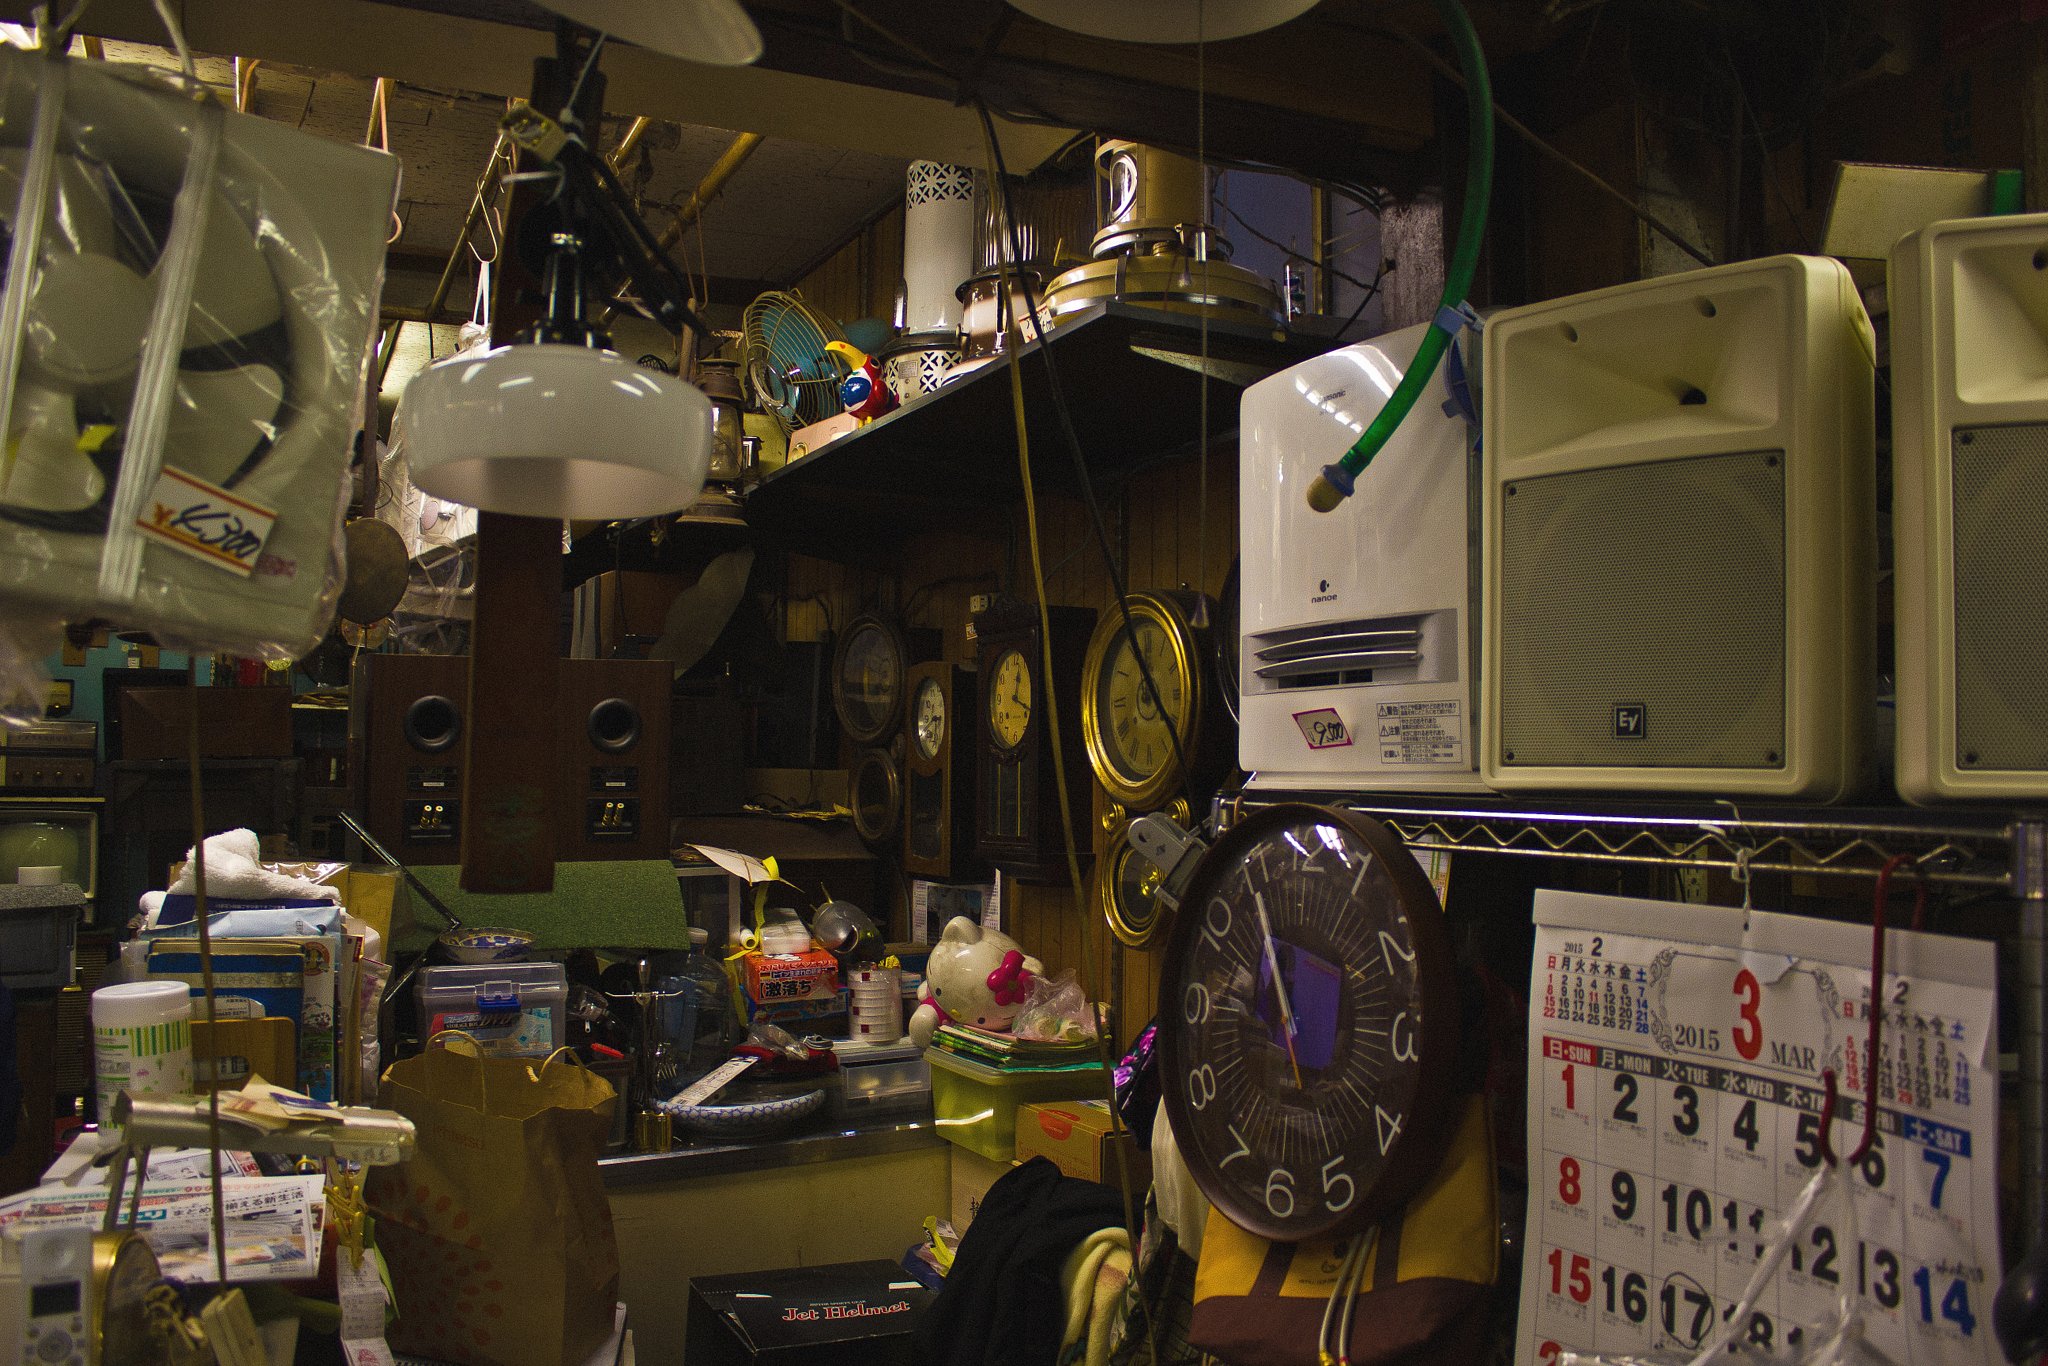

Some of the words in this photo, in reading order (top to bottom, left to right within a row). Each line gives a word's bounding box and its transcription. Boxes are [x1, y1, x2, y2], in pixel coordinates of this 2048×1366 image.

[1311, 593, 1338, 604] nanoe
[1292, 825, 1329, 872] 12
[1352, 851, 1373, 896] 1
[1199, 896, 1232, 952] 10
[1379, 916, 1416, 976] 2
[1564, 942, 1583, 954] 2015
[1591, 937, 1603, 957] 2
[1548, 955, 1556, 969] 日
[1561, 956, 1570, 971] 月
[1575, 959, 1585, 973] 火
[1590, 961, 1600, 975] 水
[1604, 962, 1615, 976] 木
[1620, 965, 1631, 979] 金
[1636, 968, 1647, 983] 土
[1549, 973, 1553, 983] 1
[1562, 975, 1568, 985] 2
[1576, 977, 1582, 987] 3
[1591, 980, 1597, 989] 4
[1606, 982, 1612, 992] 5
[1622, 984, 1628, 995] 6
[1638, 987, 1645, 997] 7
[1185, 982, 1210, 1025] 9
[1545, 996, 1555, 1007] 15
[1559, 998, 1570, 1008] 16
[1574, 1001, 1584, 1010] 17
[1589, 1003, 1599, 1014] 18
[1604, 1005, 1615, 1016] 19
[1619, 1008, 1632, 1019] 20
[1636, 1011, 1648, 1021] 21
[1547, 985, 1553, 995] 8
[1562, 986, 1568, 996] 9
[1574, 989, 1584, 999] 10
[1589, 991, 1598, 1002] 11
[1604, 994, 1615, 1005] 12
[1620, 996, 1632, 1007] 13
[1636, 999, 1648, 1009] 14
[1732, 968, 1763, 1061] 3
[1392, 1011, 1422, 1063] 3
[1543, 1007, 1555, 1018] 22
[1558, 1009, 1570, 1020] 23
[1572, 1011, 1584, 1022] 24
[1587, 1014, 1600, 1025] 25
[1603, 1017, 1615, 1028] 26
[1619, 1020, 1632, 1031] 27
[1635, 1022, 1649, 1034] 28
[1675, 1024, 1720, 1051] 2015
[1771, 1040, 1816, 1072] MAR
[1189, 1063, 1216, 1111] 8
[1219, 1123, 1250, 1169] 7
[1375, 1105, 1403, 1157] 4
[1562, 1064, 1575, 1110] 1
[1613, 1073, 1638, 1123] 2
[1673, 1085, 1699, 1136] 3
[1733, 1100, 1759, 1151] 4
[1795, 1113, 1825, 1168] 5
[1862, 1131, 1886, 1187] 6
[1923, 1148, 1951, 1209] 7
[1265, 1168, 1296, 1218] 6
[1321, 1155, 1355, 1212] 5
[1559, 1156, 1581, 1205] 8
[1611, 1171, 1637, 1221] 9
[1662, 1184, 1712, 1240] 10
[1858, 1241, 1900, 1308] 13
[1913, 1266, 1977, 1336] 14
[782, 1307, 820, 1320] Jet
[823, 1300, 911, 1320] Helmet
[1549, 1248, 1592, 1303] 15
[1602, 1266, 1647, 1323] 16
[1661, 1285, 1711, 1341] 17
